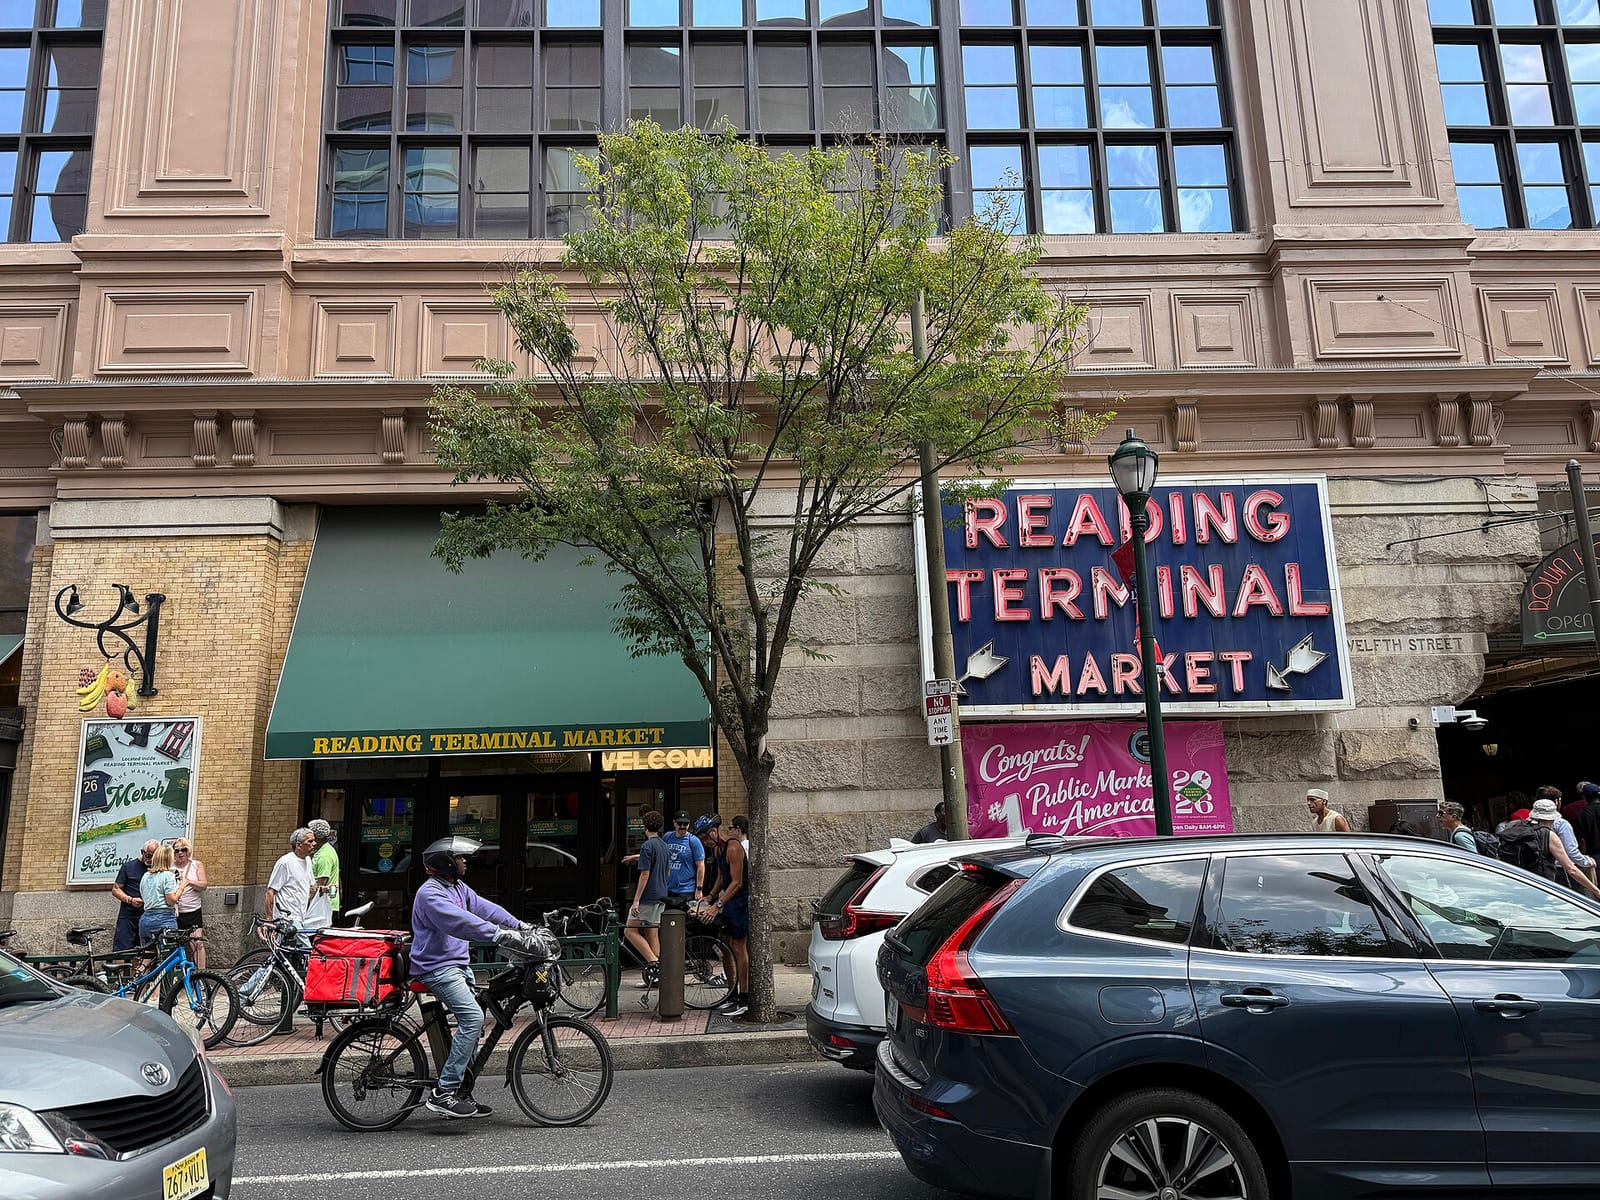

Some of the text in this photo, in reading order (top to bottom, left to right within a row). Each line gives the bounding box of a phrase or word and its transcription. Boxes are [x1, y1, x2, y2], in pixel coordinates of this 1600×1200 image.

[965, 489, 1291, 549] READING
[1547, 613, 1593, 630] OPEN
[1409, 637, 1463, 652] STREET
[1030, 650, 1254, 697] MARKET
[928, 706, 951, 715] STOPPING
[933, 697, 944, 707] NO
[933, 717, 947, 725] ANY
[312, 728, 665, 754] READING TERMINAL MARKET
[601, 749, 713, 771] WELCOM
[979, 735, 1091, 783] Congrats!
[83, 779, 98, 793] 26
[101, 780, 166, 813] Merch
[1026, 777, 1094, 816] Public
[1090, 766, 1153, 799] Marke
[1042, 794, 1155, 835] in America
[1184, 823, 1198, 831] Daily
